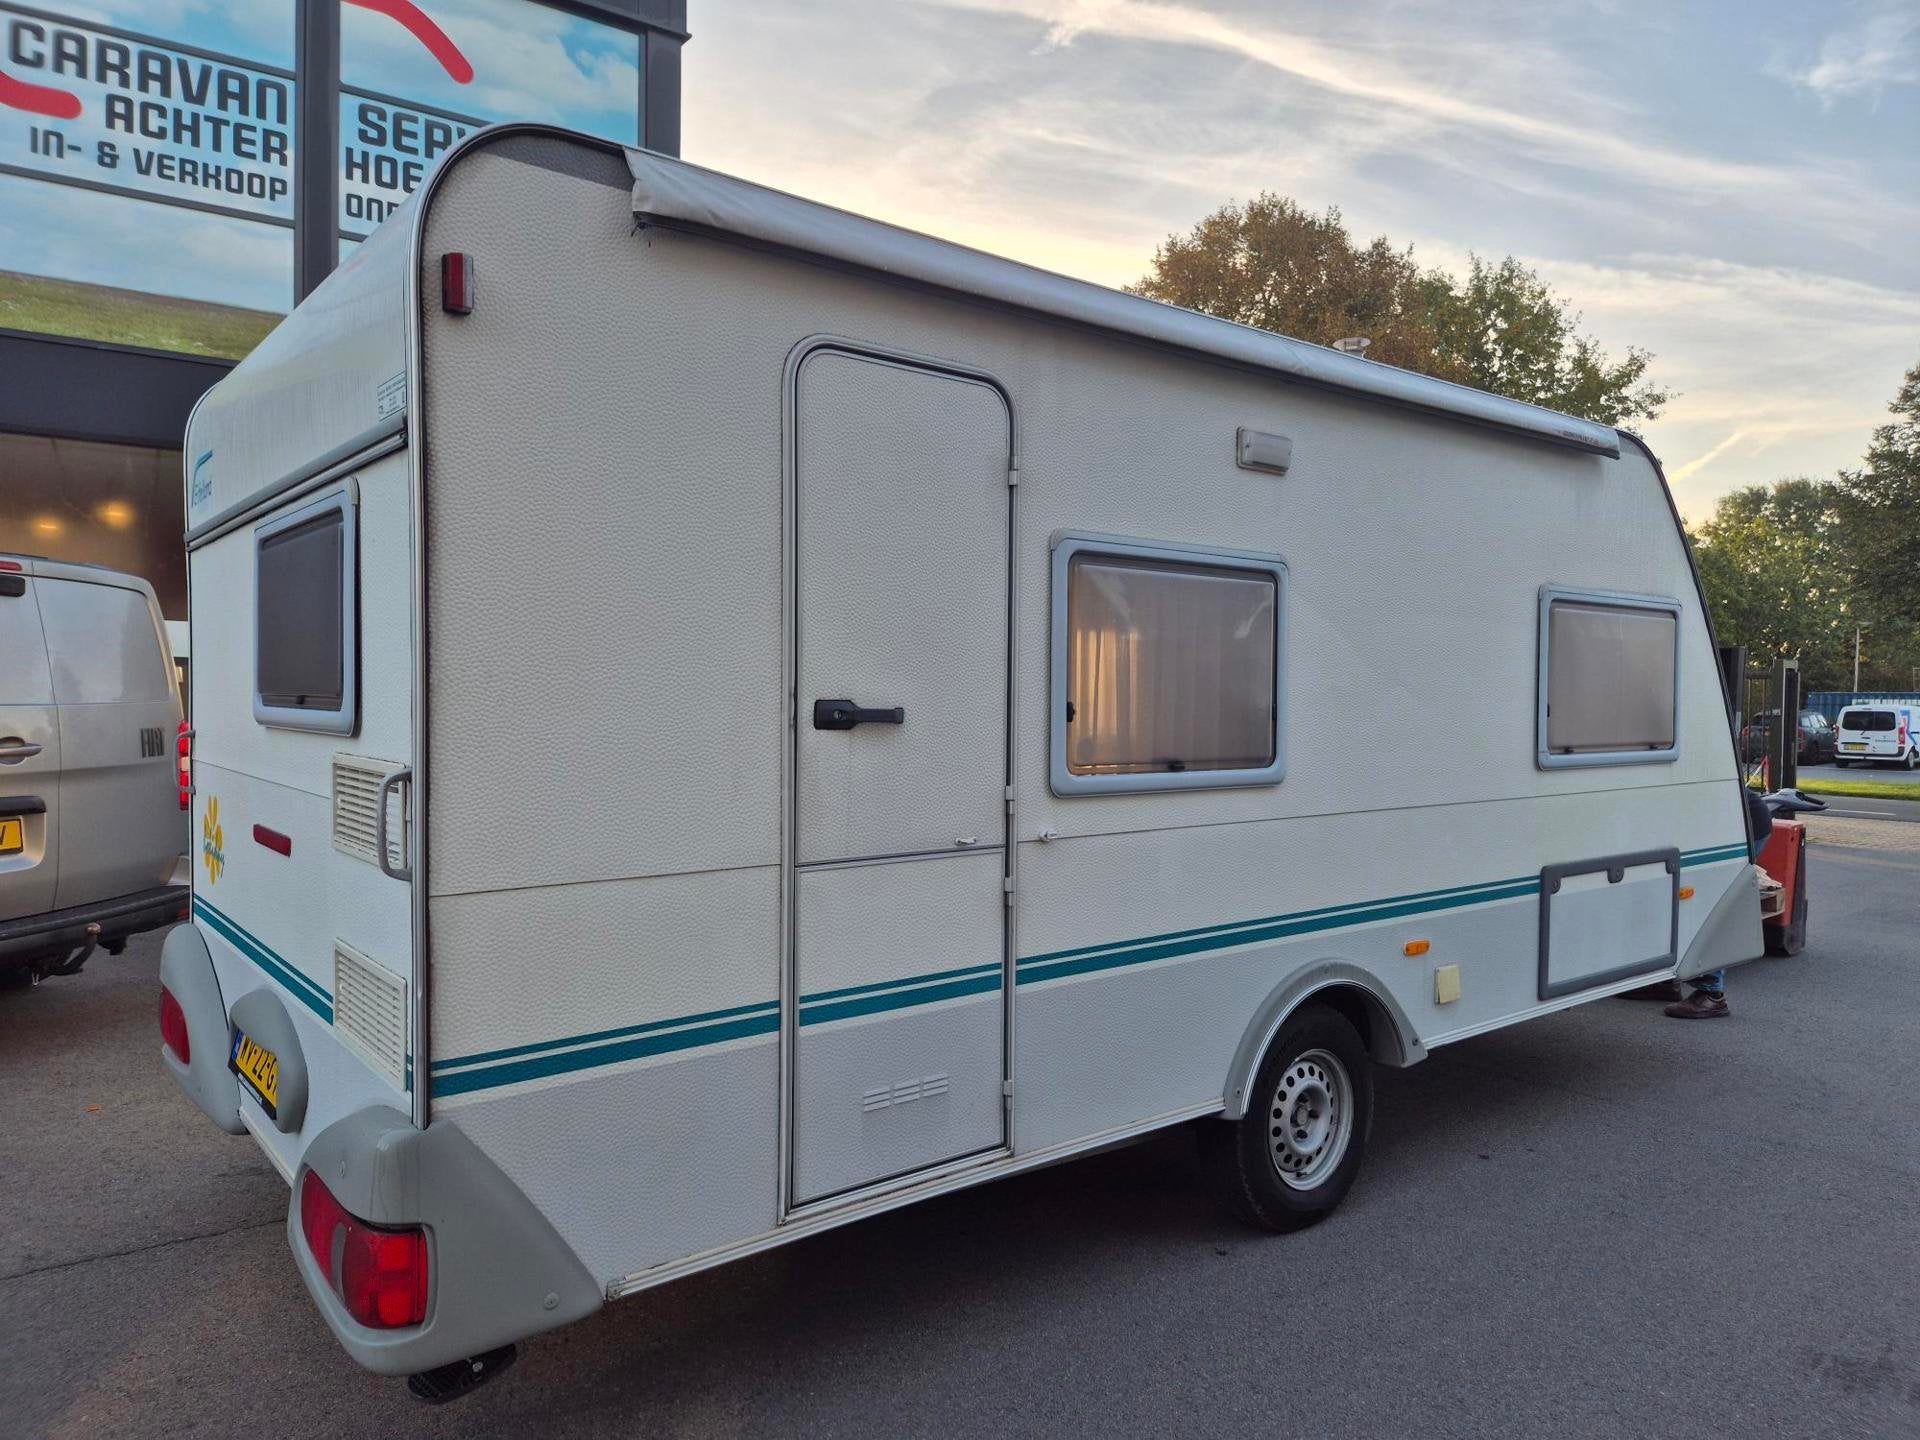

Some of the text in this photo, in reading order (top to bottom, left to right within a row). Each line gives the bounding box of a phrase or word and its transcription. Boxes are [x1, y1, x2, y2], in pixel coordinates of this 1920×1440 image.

[8, 19, 288, 125] CARAVAN
[29, 126, 288, 201] IN- & VERKOOP
[105, 93, 288, 167] ACHTER
